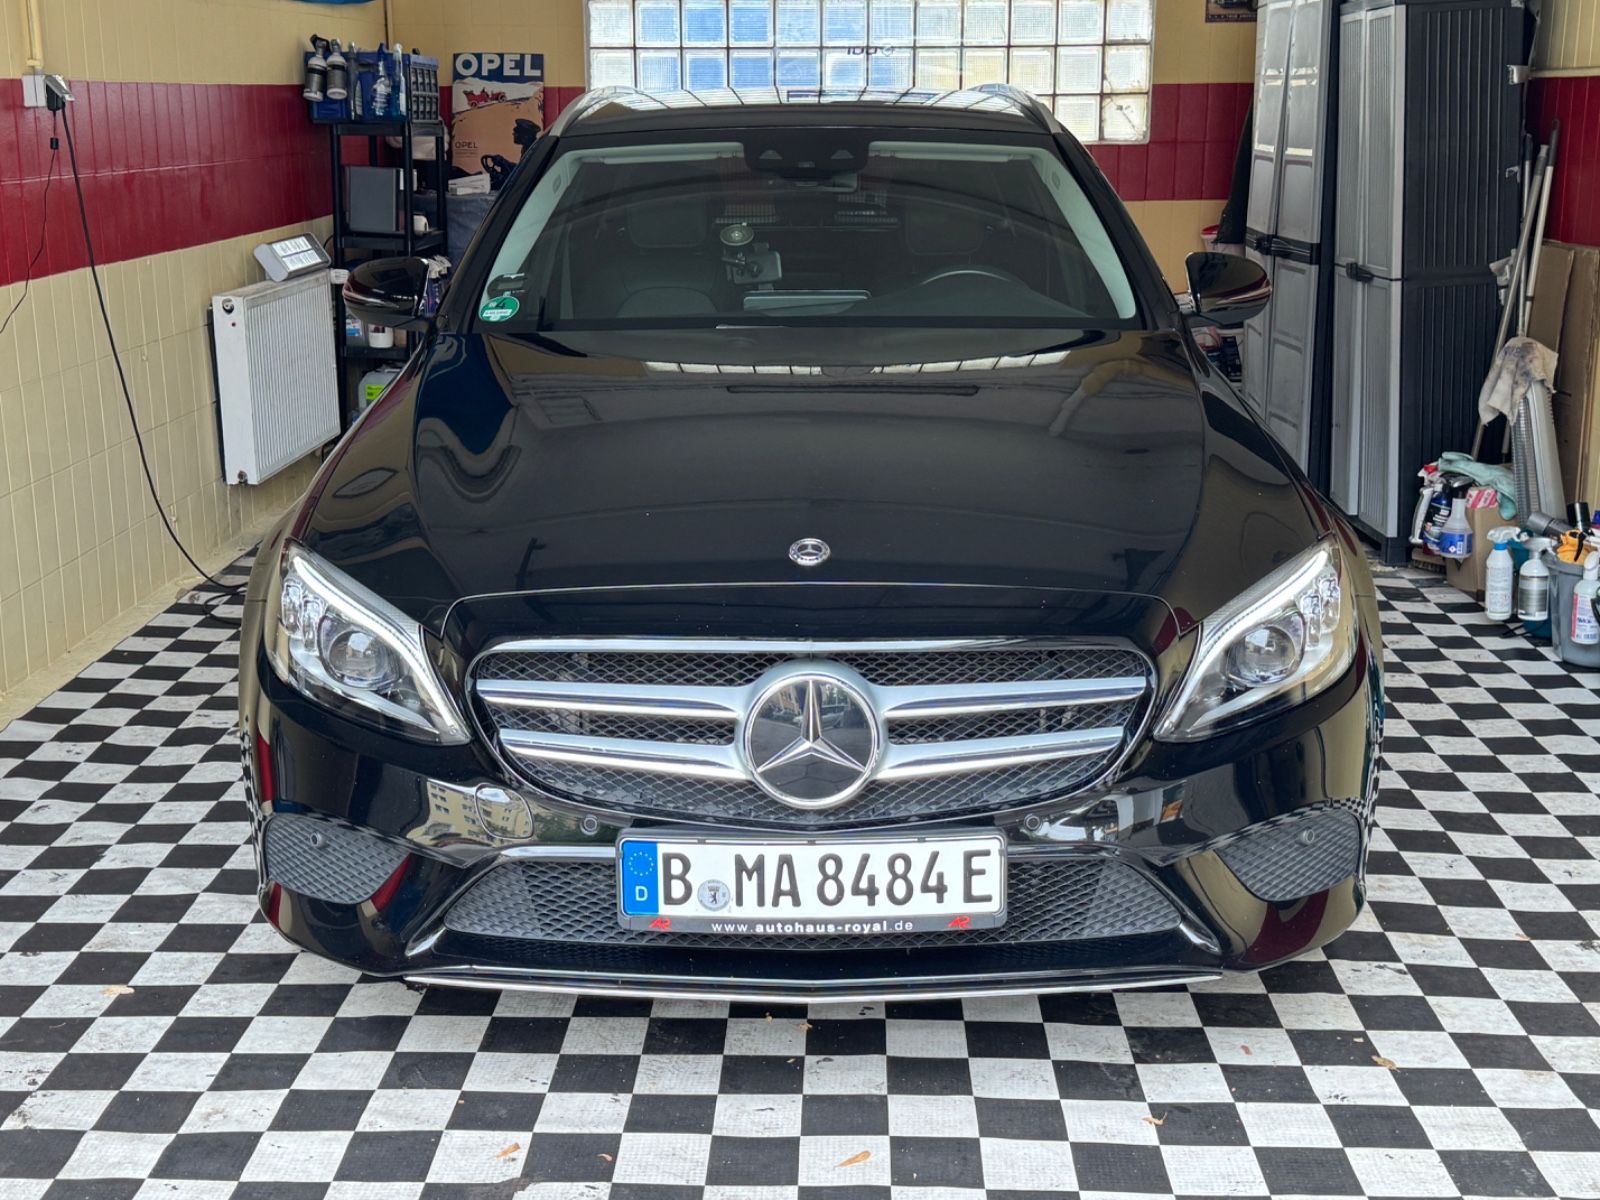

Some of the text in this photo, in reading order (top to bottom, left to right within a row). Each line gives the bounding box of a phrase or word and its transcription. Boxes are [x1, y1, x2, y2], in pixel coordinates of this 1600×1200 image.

[455, 53, 541, 77] OPEL
[455, 141, 479, 149] OPEL
[495, 297, 506, 309] 4
[662, 852, 693, 906] B
[734, 853, 801, 908] MA
[635, 886, 648, 901] D
[711, 920, 914, 935] www.autohaus-royal.de
